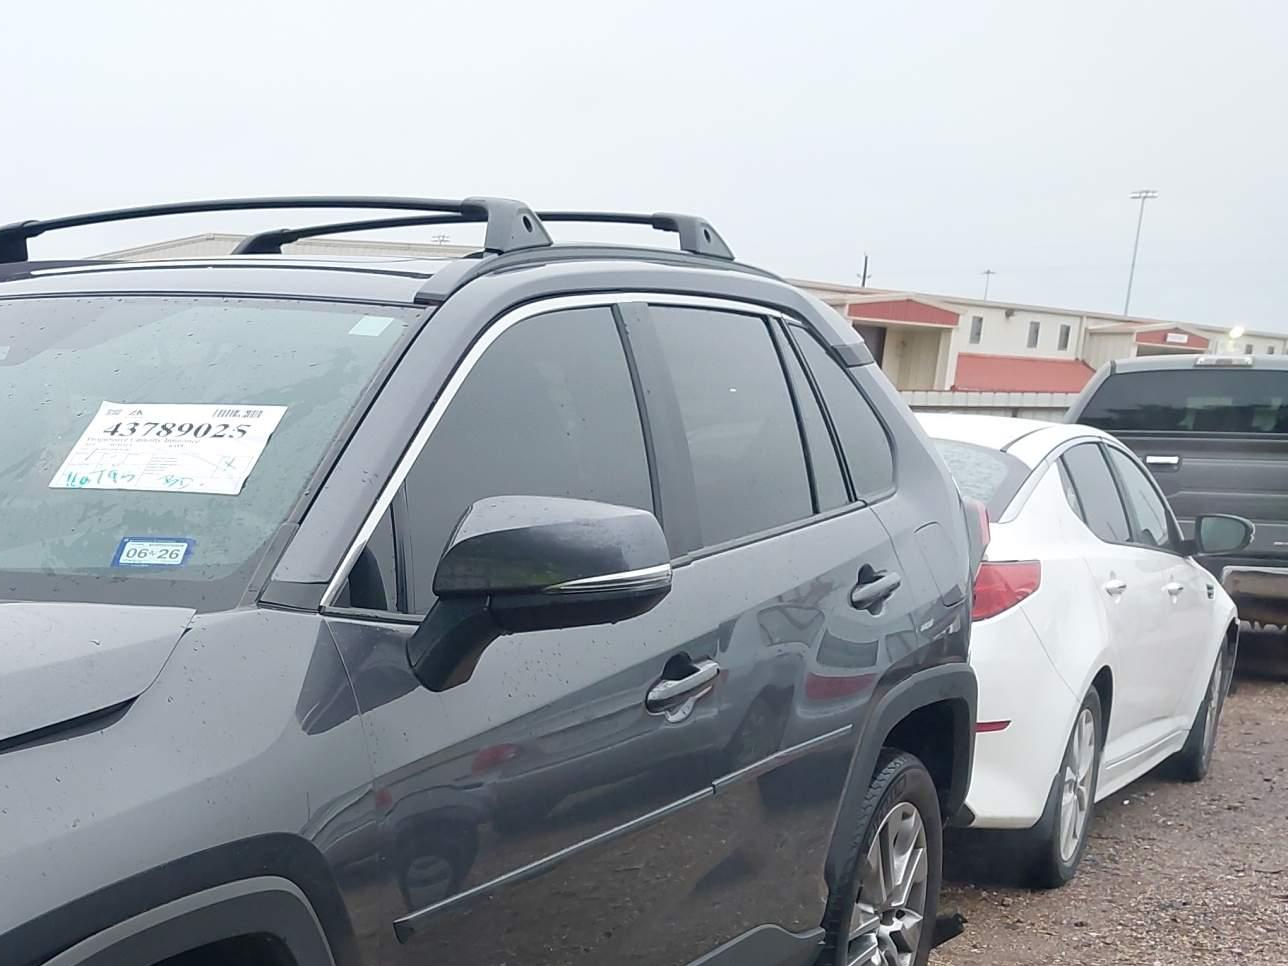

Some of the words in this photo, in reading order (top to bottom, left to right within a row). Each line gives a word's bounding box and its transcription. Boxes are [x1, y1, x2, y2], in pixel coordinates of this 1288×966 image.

[103, 421, 252, 439] 43789025
[126, 547, 149, 559] 06
[157, 548, 181, 560] 26
